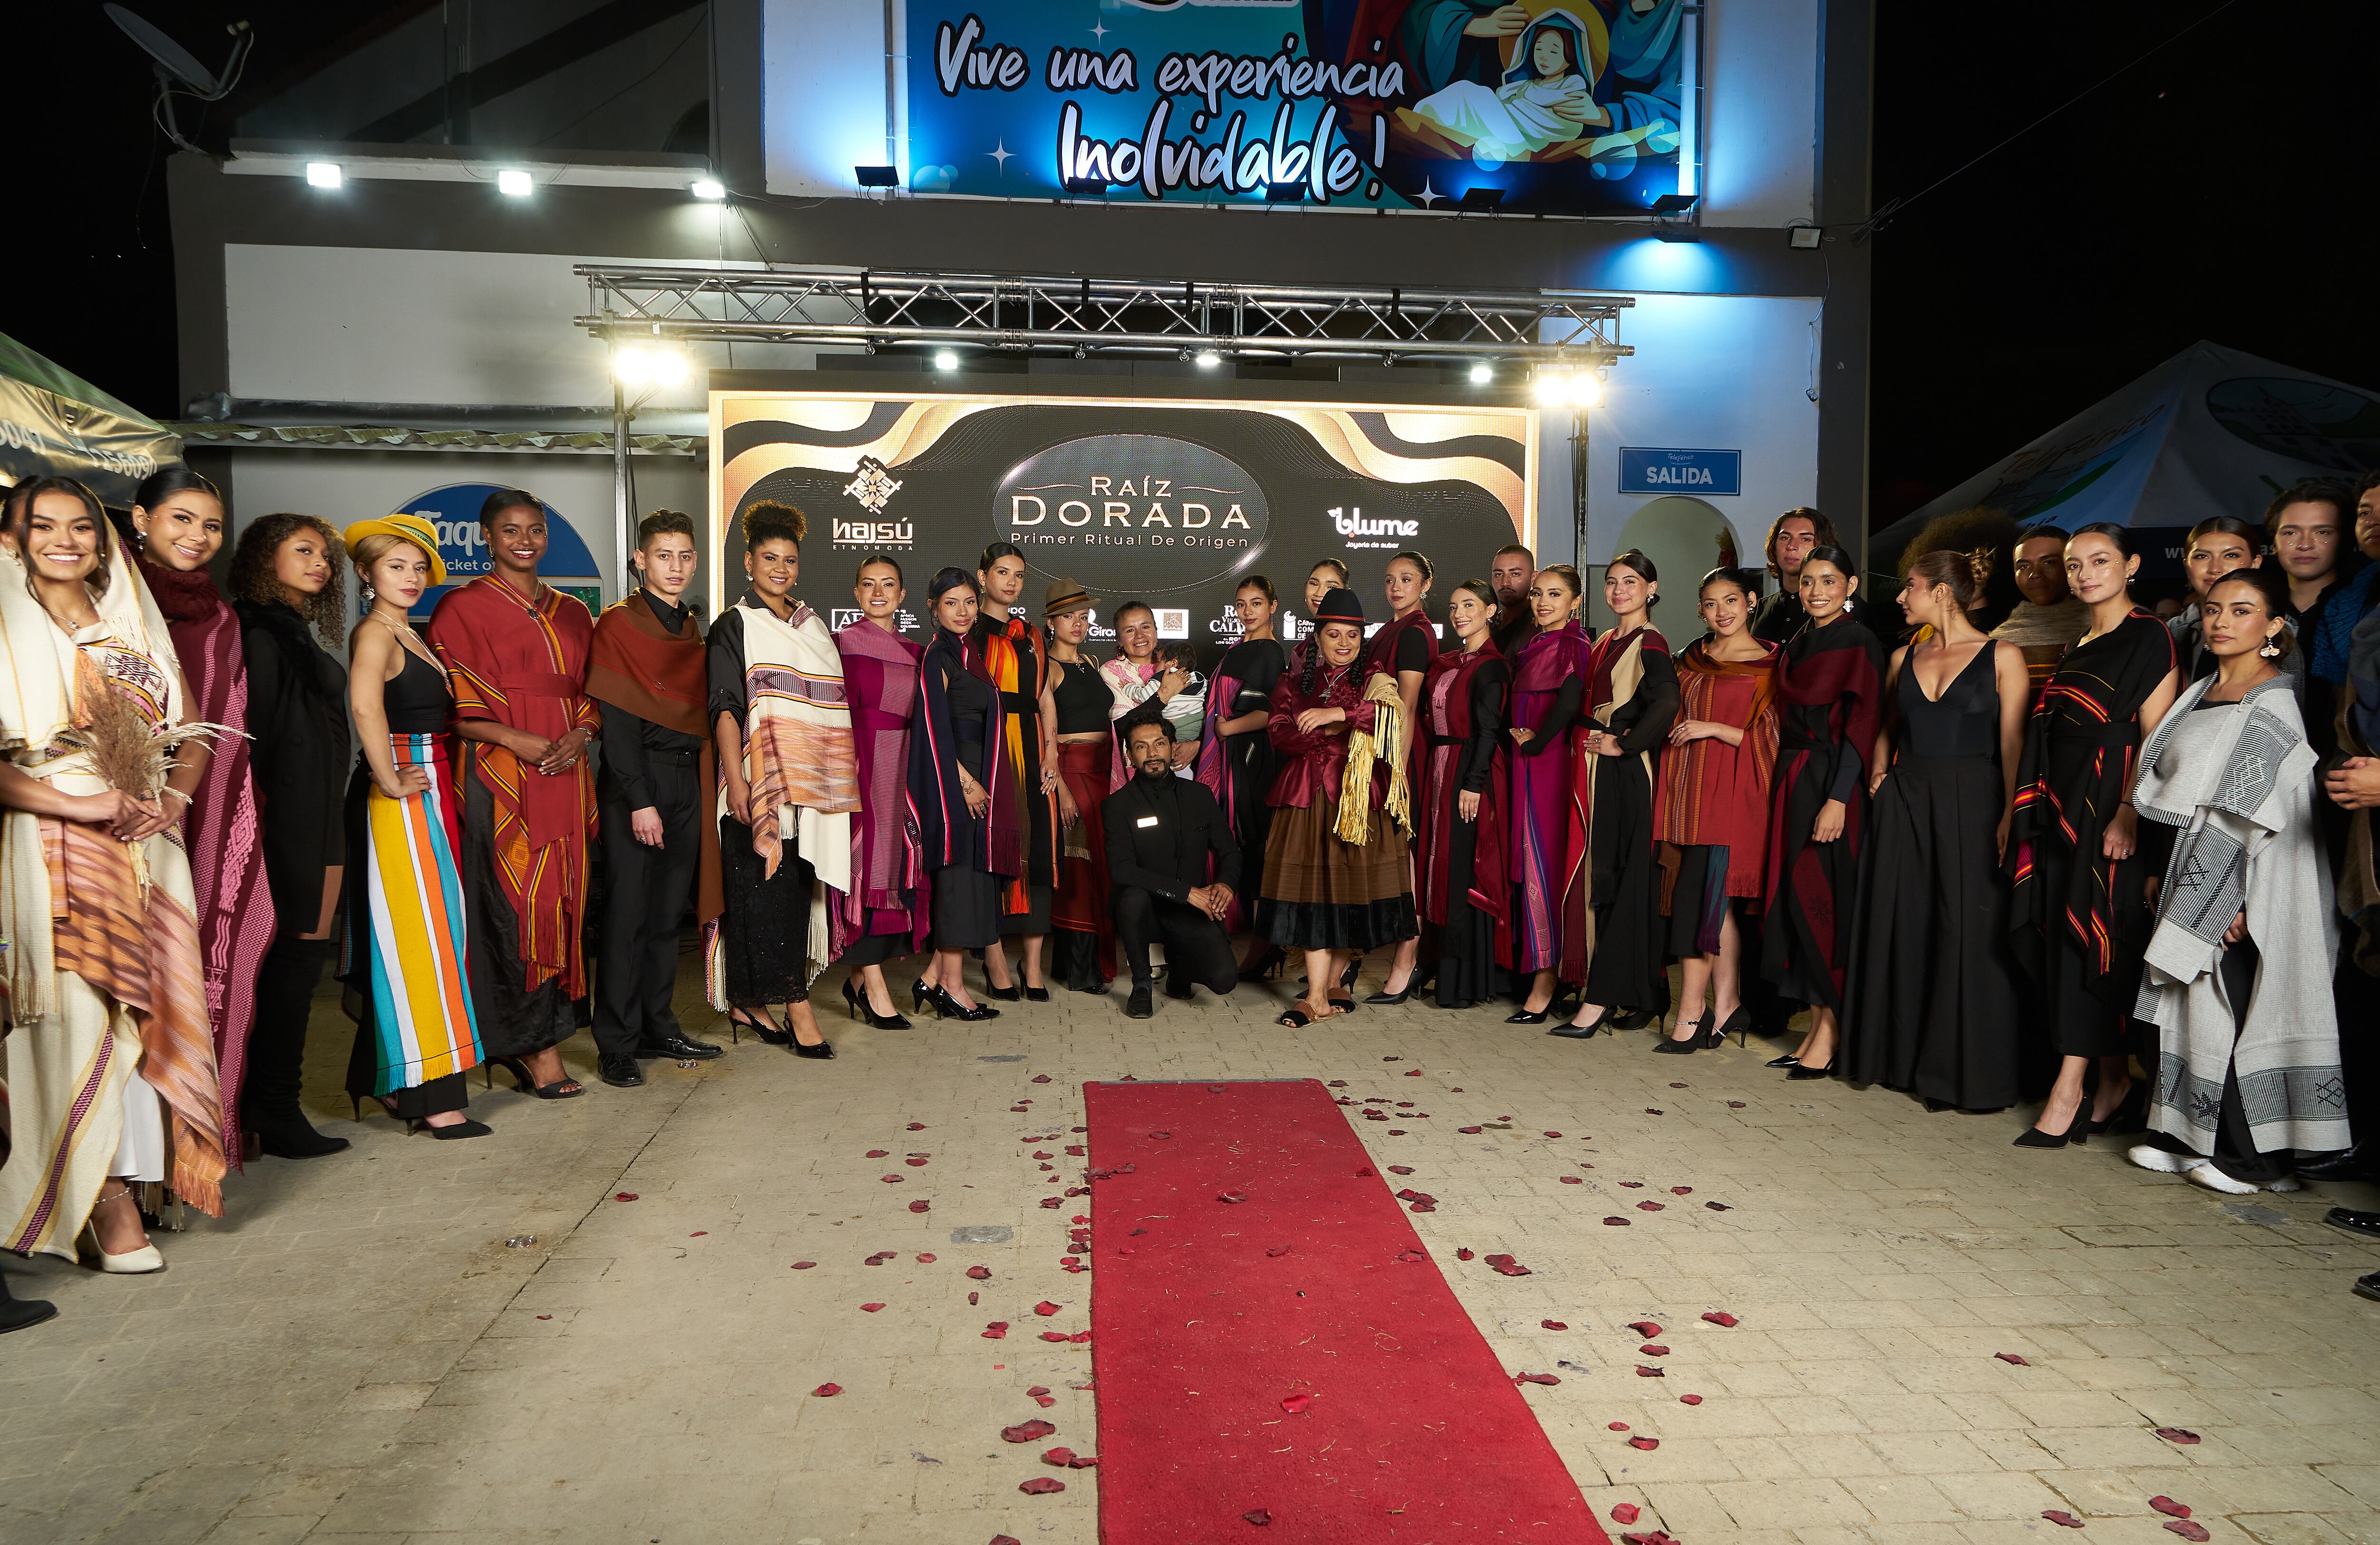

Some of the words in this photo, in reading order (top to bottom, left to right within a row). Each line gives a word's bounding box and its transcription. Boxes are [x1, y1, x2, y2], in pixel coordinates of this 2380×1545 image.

[939, 17, 1026, 93] Vive
[1050, 50, 1135, 90] una
[1159, 36, 1406, 114] experiencia
[1646, 466, 1714, 485] SALIDA
[1011, 495, 1251, 530] DORADA
[1335, 507, 1419, 536] blume
[414, 510, 488, 557] Taqu
[1011, 533, 1075, 545] Primer
[1085, 534, 1141, 546] Ritual
[1151, 535, 1174, 546] De
[1184, 535, 1248, 549] Origen
